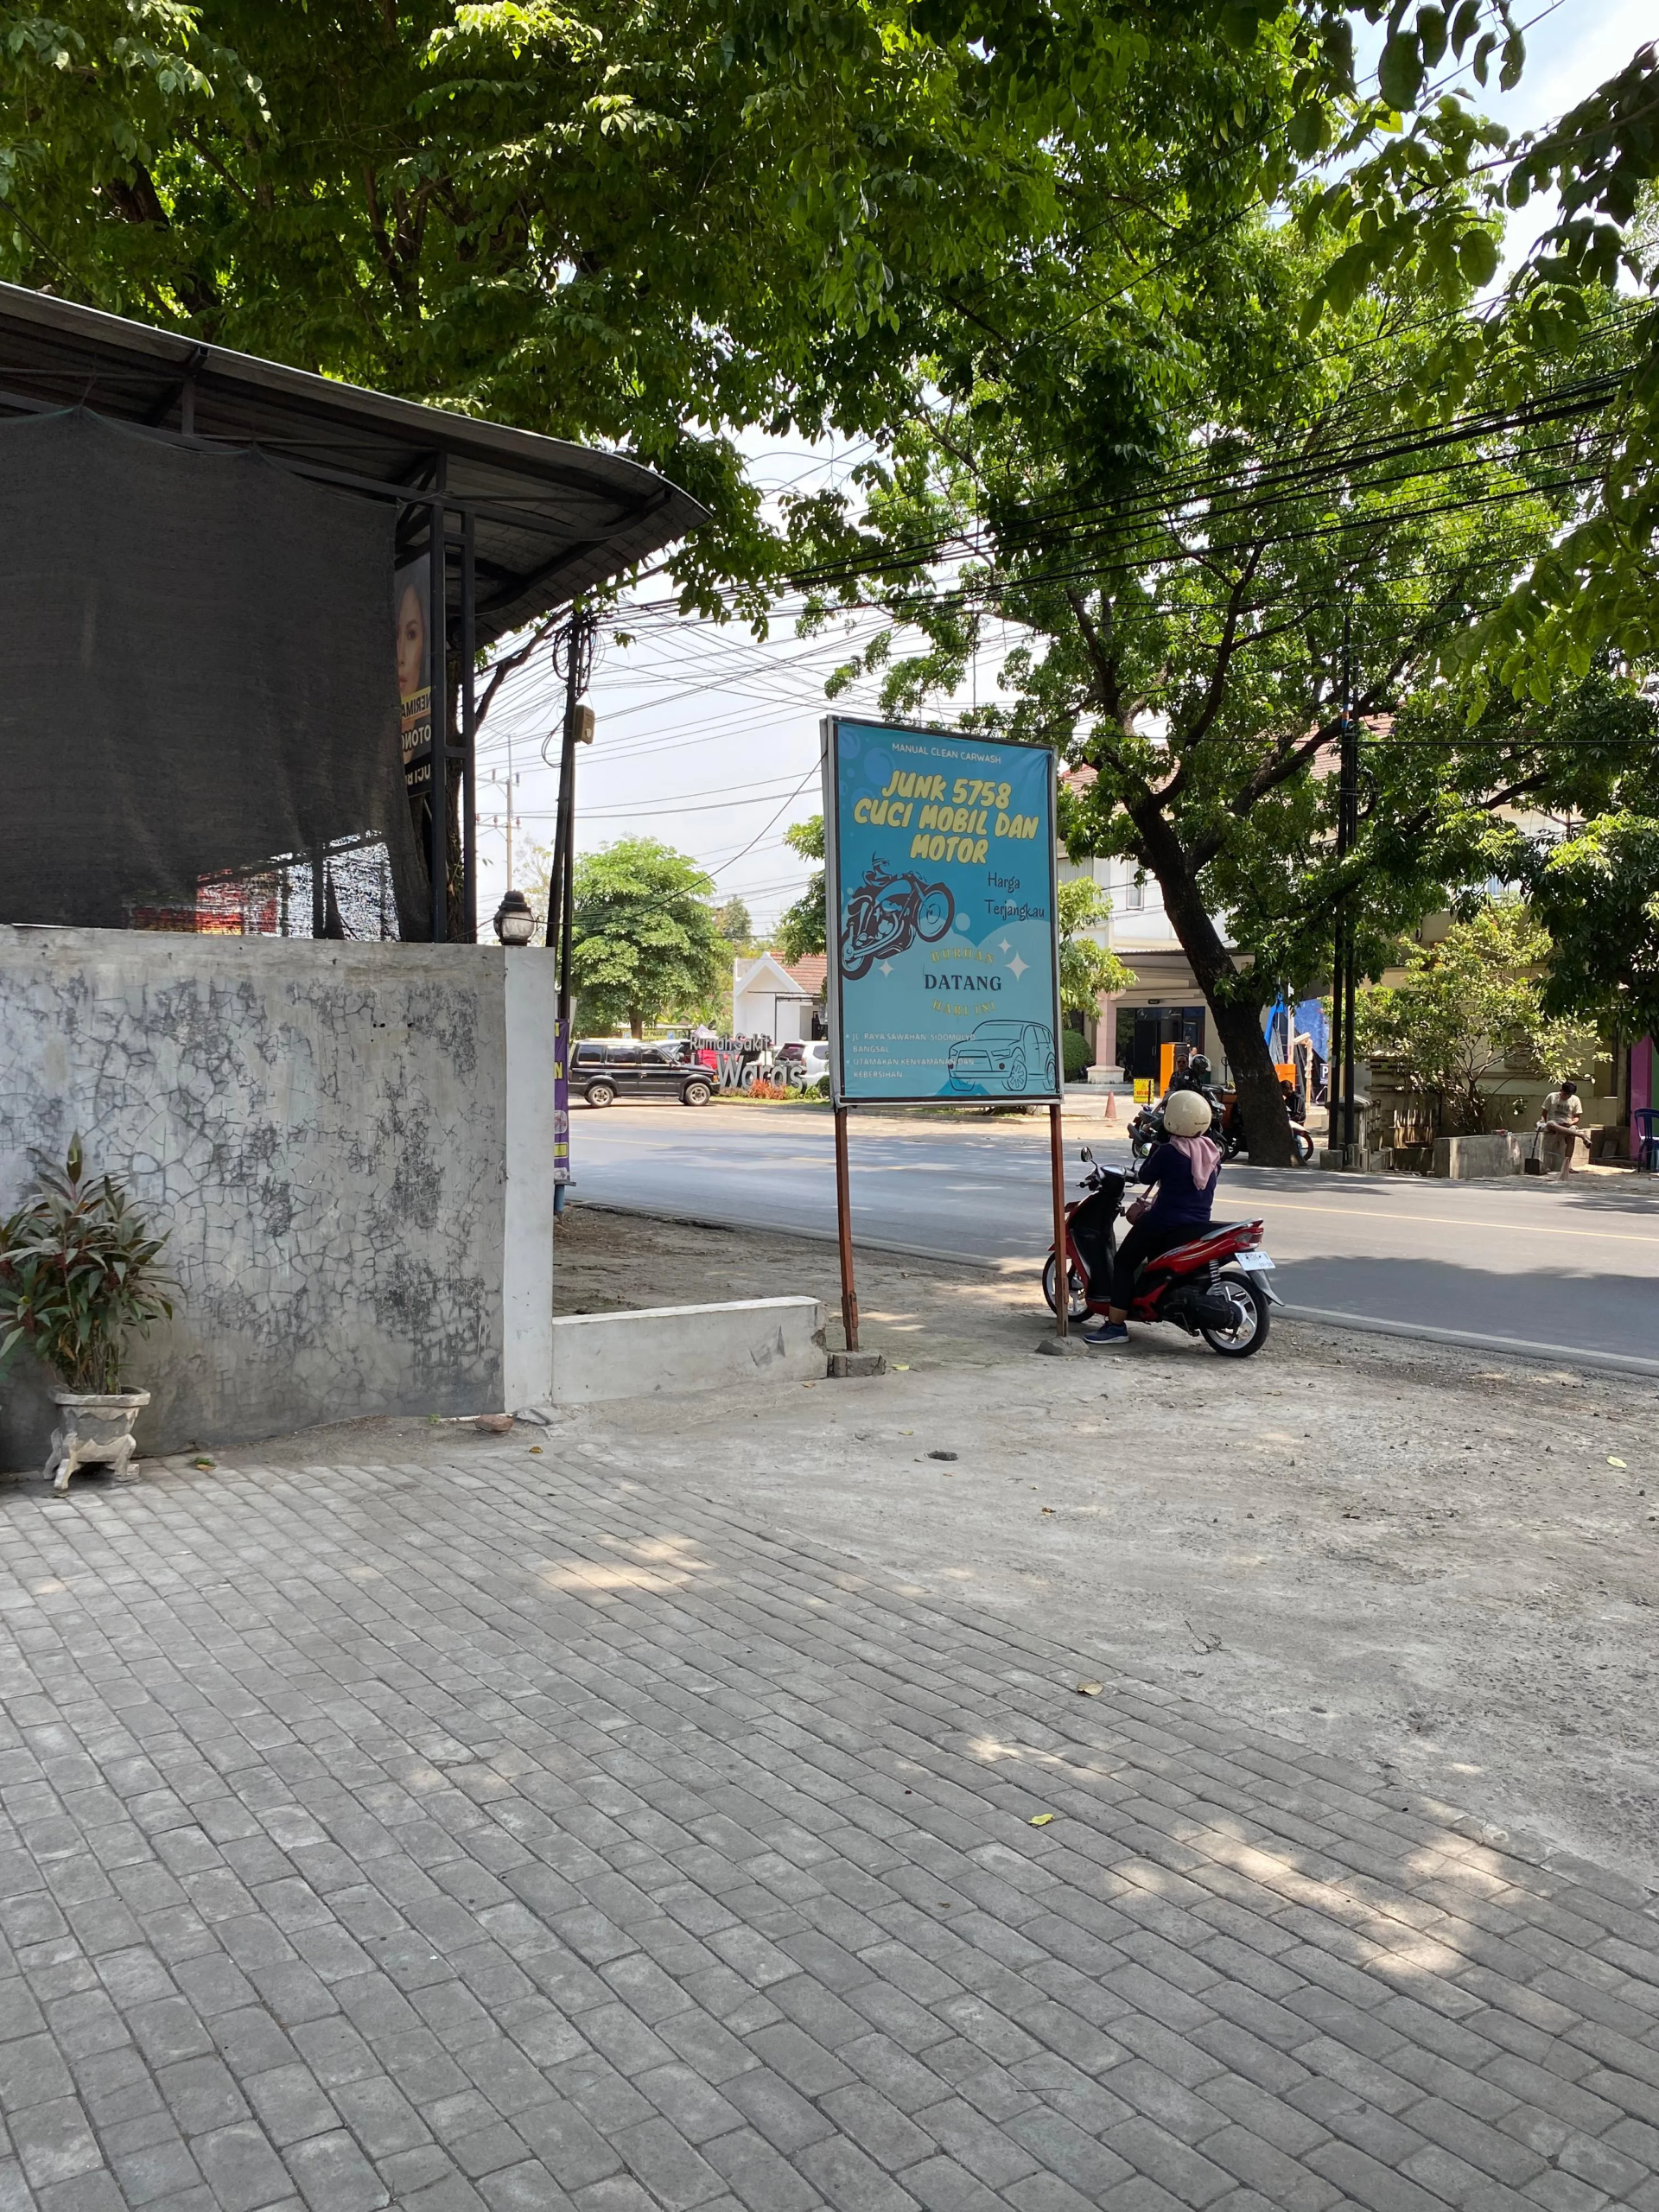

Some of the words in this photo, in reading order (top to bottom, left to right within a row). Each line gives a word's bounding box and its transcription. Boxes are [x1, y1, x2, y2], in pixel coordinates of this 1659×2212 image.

[892, 742, 929, 755] MANUAL
[931, 747, 958, 759] CLEAN
[960, 752, 1001, 764] CARWASH
[881, 770, 947, 802] JUNK
[951, 779, 1012, 810] 5758
[854, 798, 913, 828] CUCI
[918, 804, 988, 836] MOBIL
[995, 811, 1039, 840] DAN
[910, 834, 989, 864] MOTOR
[988, 871, 1020, 893] Harga
[984, 899, 1045, 921] Terjangkau
[931, 948, 995, 964] BURUAN
[925, 974, 1002, 991] DATANG
[932, 999, 968, 1015] HARI
[975, 1001, 996, 1015] INI
[690, 1033, 732, 1051] Rumah
[734, 1033, 772, 1052] Sakit
[853, 1045, 889, 1053] BANGSAL
